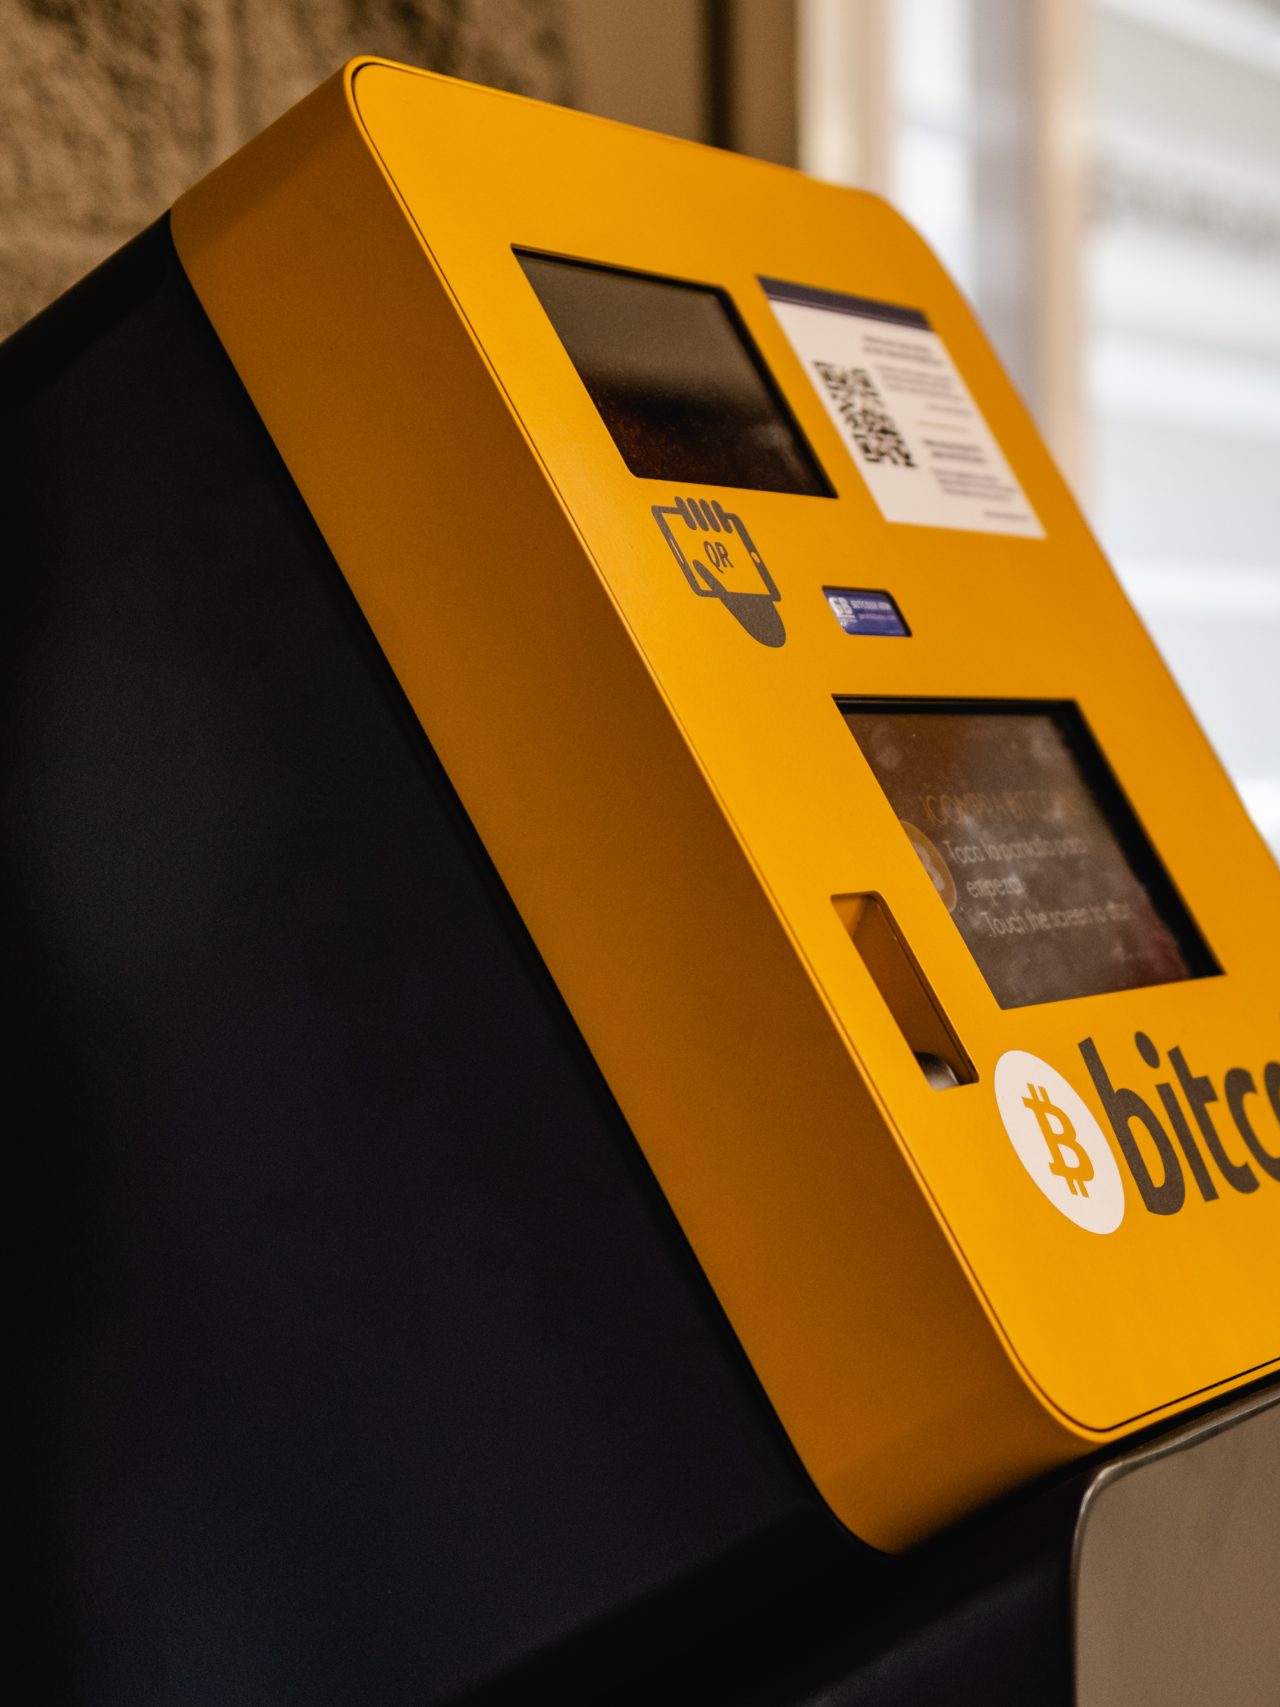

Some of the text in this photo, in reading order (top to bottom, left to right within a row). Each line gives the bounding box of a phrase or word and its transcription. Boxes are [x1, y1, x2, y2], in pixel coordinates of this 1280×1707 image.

[703, 540, 734, 573] QR
[980, 911, 1028, 935] Touch
[1024, 908, 1051, 931] the
